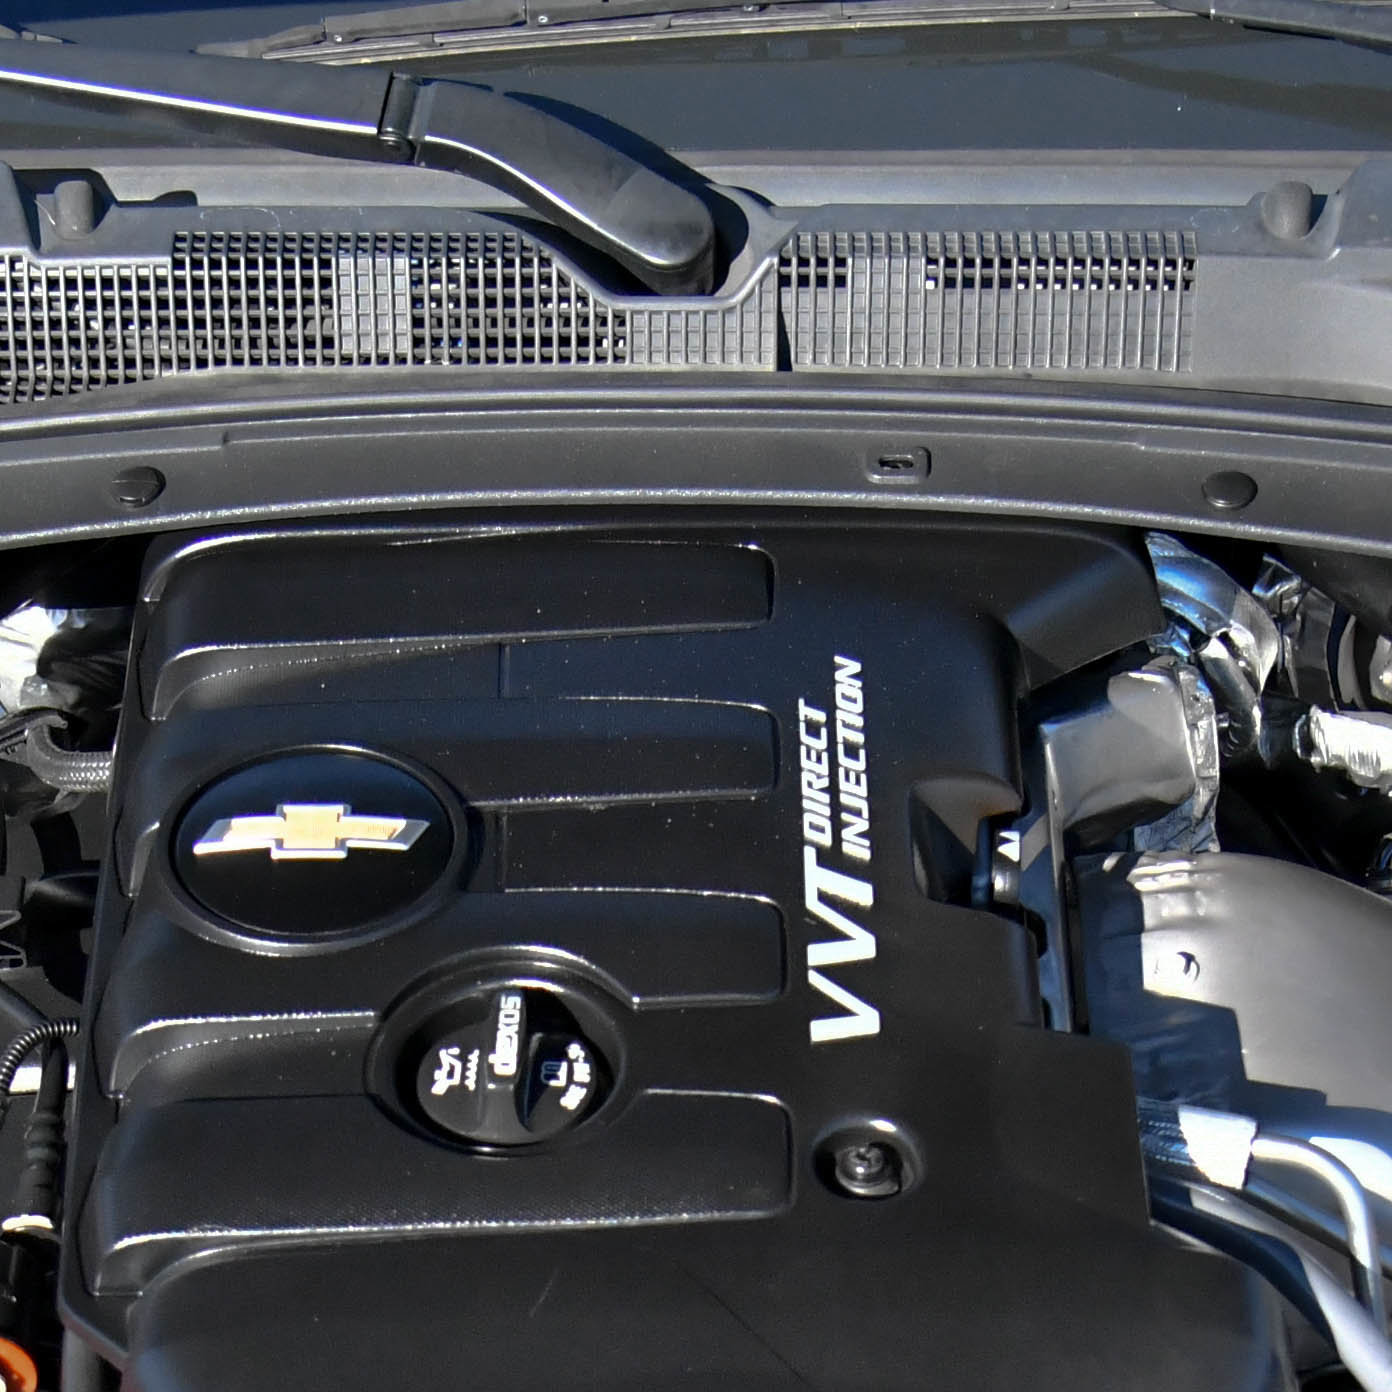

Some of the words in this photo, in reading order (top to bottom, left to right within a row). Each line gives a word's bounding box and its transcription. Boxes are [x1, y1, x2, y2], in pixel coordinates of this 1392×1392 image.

[798, 697, 832, 848] DIRECT
[833, 655, 872, 862] INJECTION
[804, 845, 881, 1043] VVT
[488, 996, 521, 1075] dexos
